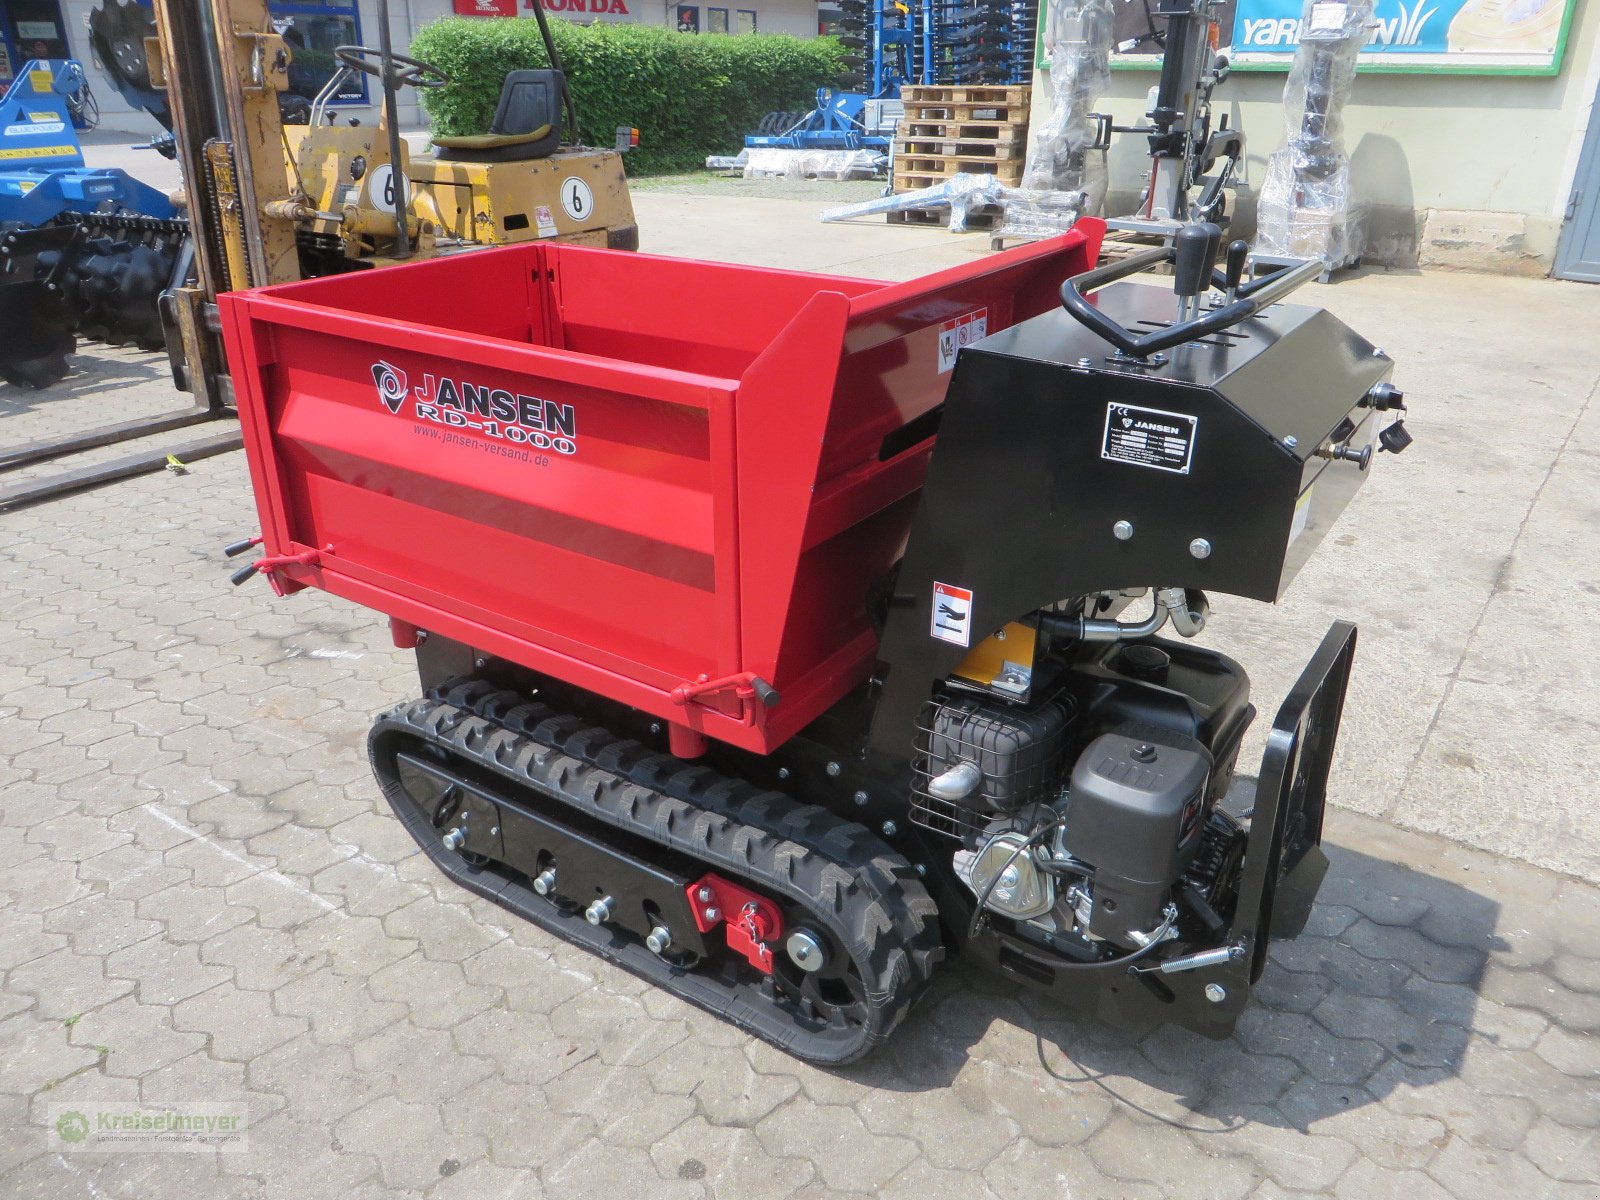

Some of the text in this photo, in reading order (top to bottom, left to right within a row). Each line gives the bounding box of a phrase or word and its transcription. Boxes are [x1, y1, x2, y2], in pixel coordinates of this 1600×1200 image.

[384, 173, 397, 206] 6
[384, 173, 396, 206] 6
[414, 373, 576, 438] JANSEN
[413, 424, 549, 467] www.jansen-versand.de
[415, 402, 577, 455] RD-1000
[1134, 421, 1179, 435] JANSEN
